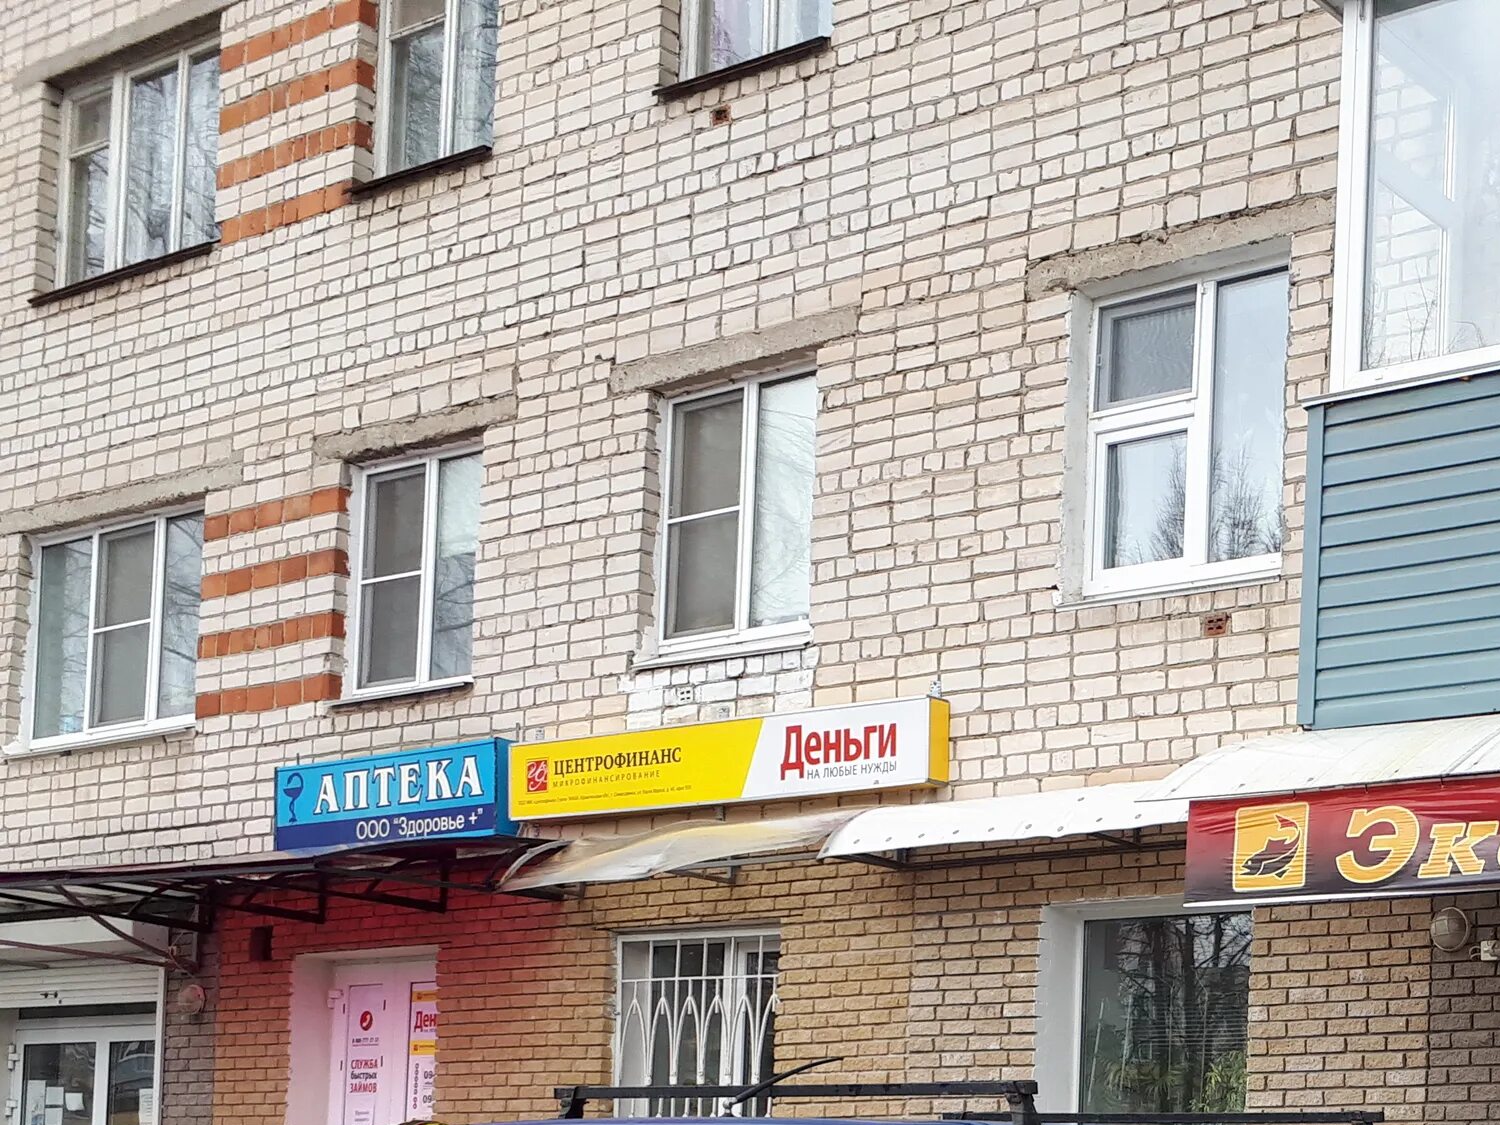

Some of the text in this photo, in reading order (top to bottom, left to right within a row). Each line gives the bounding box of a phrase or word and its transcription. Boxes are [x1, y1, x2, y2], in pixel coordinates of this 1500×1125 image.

[781, 723, 897, 780] Деньги
[554, 747, 682, 777] ЦЕНТРОФИНАНС
[807, 761, 897, 780] НА ЛЮБЫЕ НУЖДЫ
[313, 755, 484, 815] АПТЕКА
[553, 770, 661, 787] МИКРОФИНАНСИРОВАНИЕ
[356, 818, 390, 840] ООО
[351, 1059, 378, 1069] СЛУЖБА
[351, 1071, 377, 1081] быстрых
[349, 1081, 377, 1093] ЗАЙМОВ
